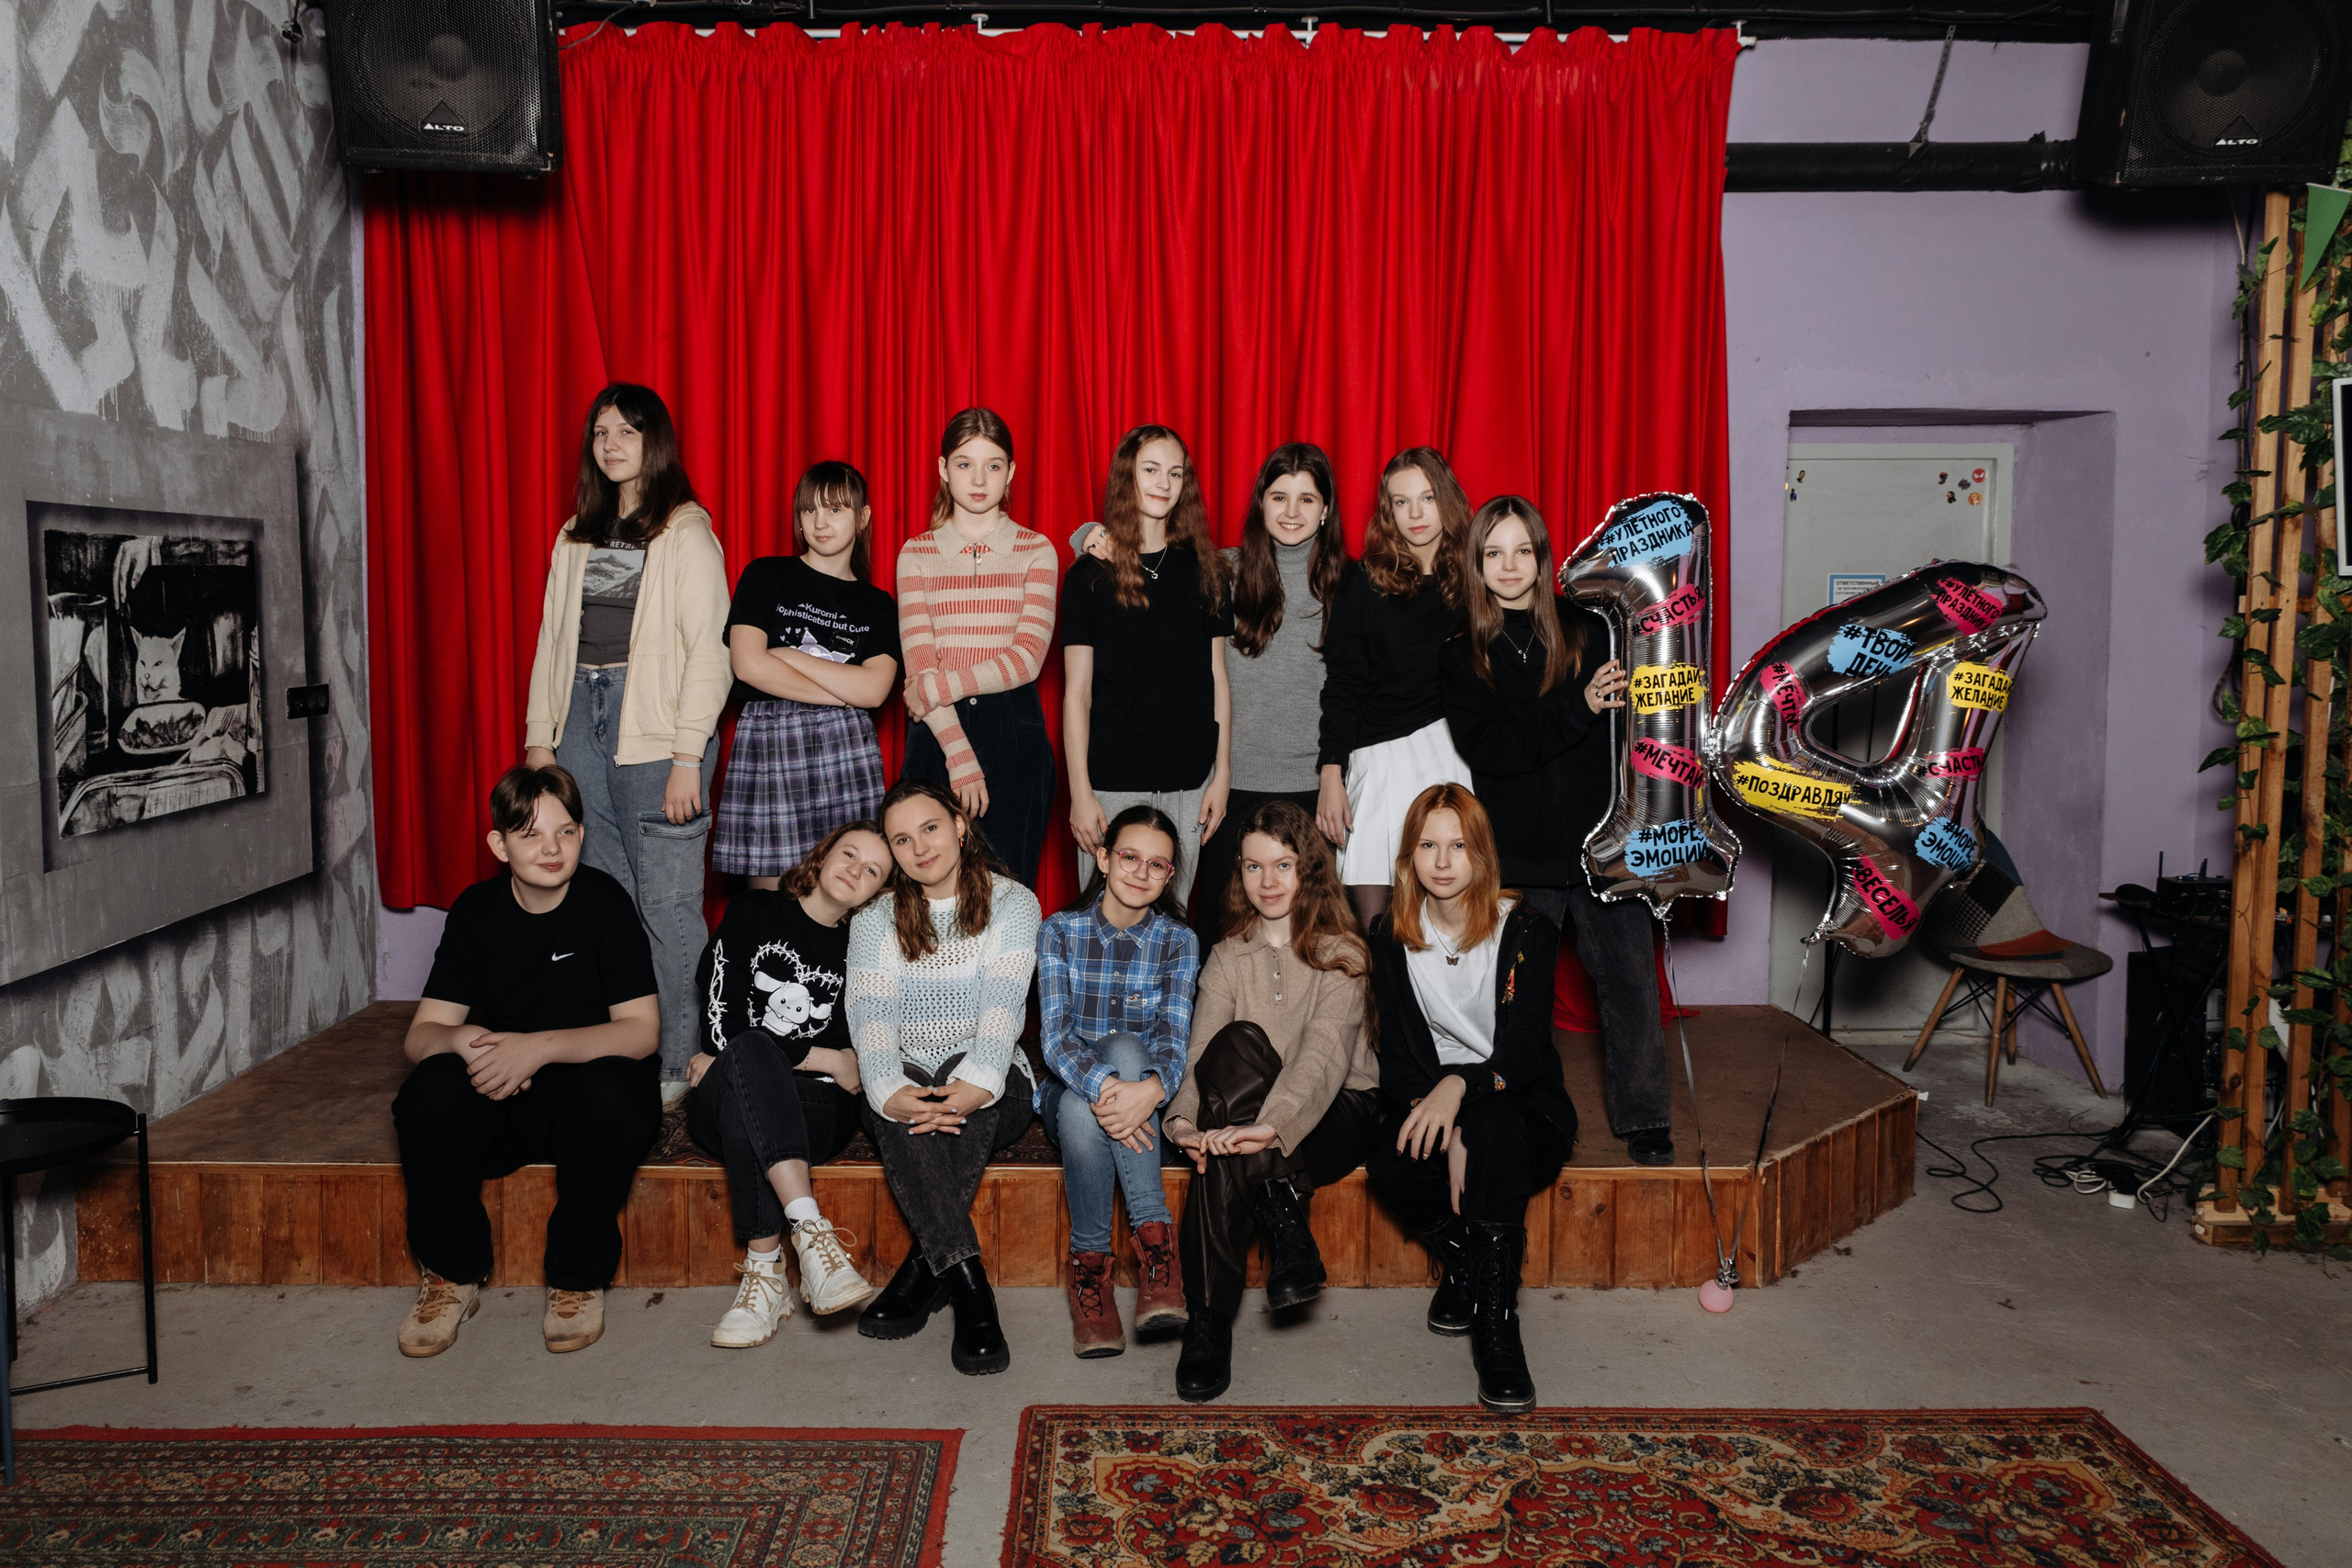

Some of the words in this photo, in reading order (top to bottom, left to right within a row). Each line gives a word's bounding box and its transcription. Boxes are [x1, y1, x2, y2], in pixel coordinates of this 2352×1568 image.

[424, 122, 464, 132] ALTO
[2215, 138, 2258, 146] ALTO
[1610, 520, 1694, 565] ПРАЗДНИКА
[805, 603, 838, 619] Kuromi
[1632, 586, 1704, 636] #СЧАСТЬЯ
[832, 621, 848, 631] but
[849, 625, 870, 633] Cute
[835, 635, 855, 646] CHECK
[1843, 626, 1916, 664] #ТВОЙ
[1843, 651, 1893, 679] ДЕНЬ
[1635, 687, 1695, 708] ЖЕЛАНИЕ
[1951, 686, 2005, 709] ЖЕЛАНИЕ
[1634, 742, 1704, 790] #МЕЧТАЙ
[1639, 821, 1698, 846] #МОРЕ
[1942, 822, 1977, 860] #МОРЕ
[1852, 860, 1917, 933] #ВЕСЕЛЬЯ
